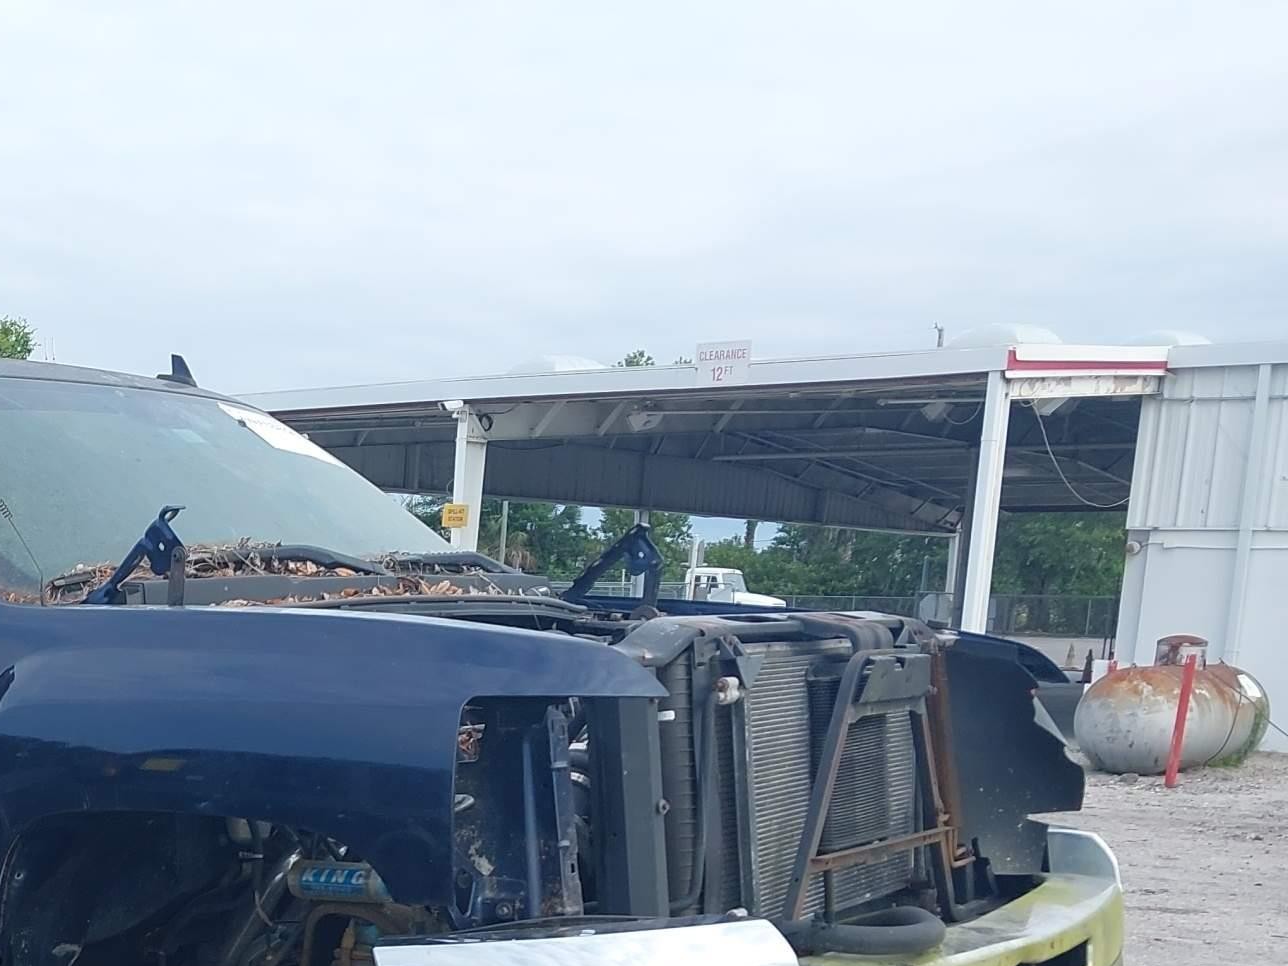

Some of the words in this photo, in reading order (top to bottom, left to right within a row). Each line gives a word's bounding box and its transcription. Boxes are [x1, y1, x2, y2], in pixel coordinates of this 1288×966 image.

[699, 348, 747, 361] CLEARANCE
[712, 366, 723, 381] 12
[724, 366, 733, 375] FT
[302, 868, 367, 885] KING
